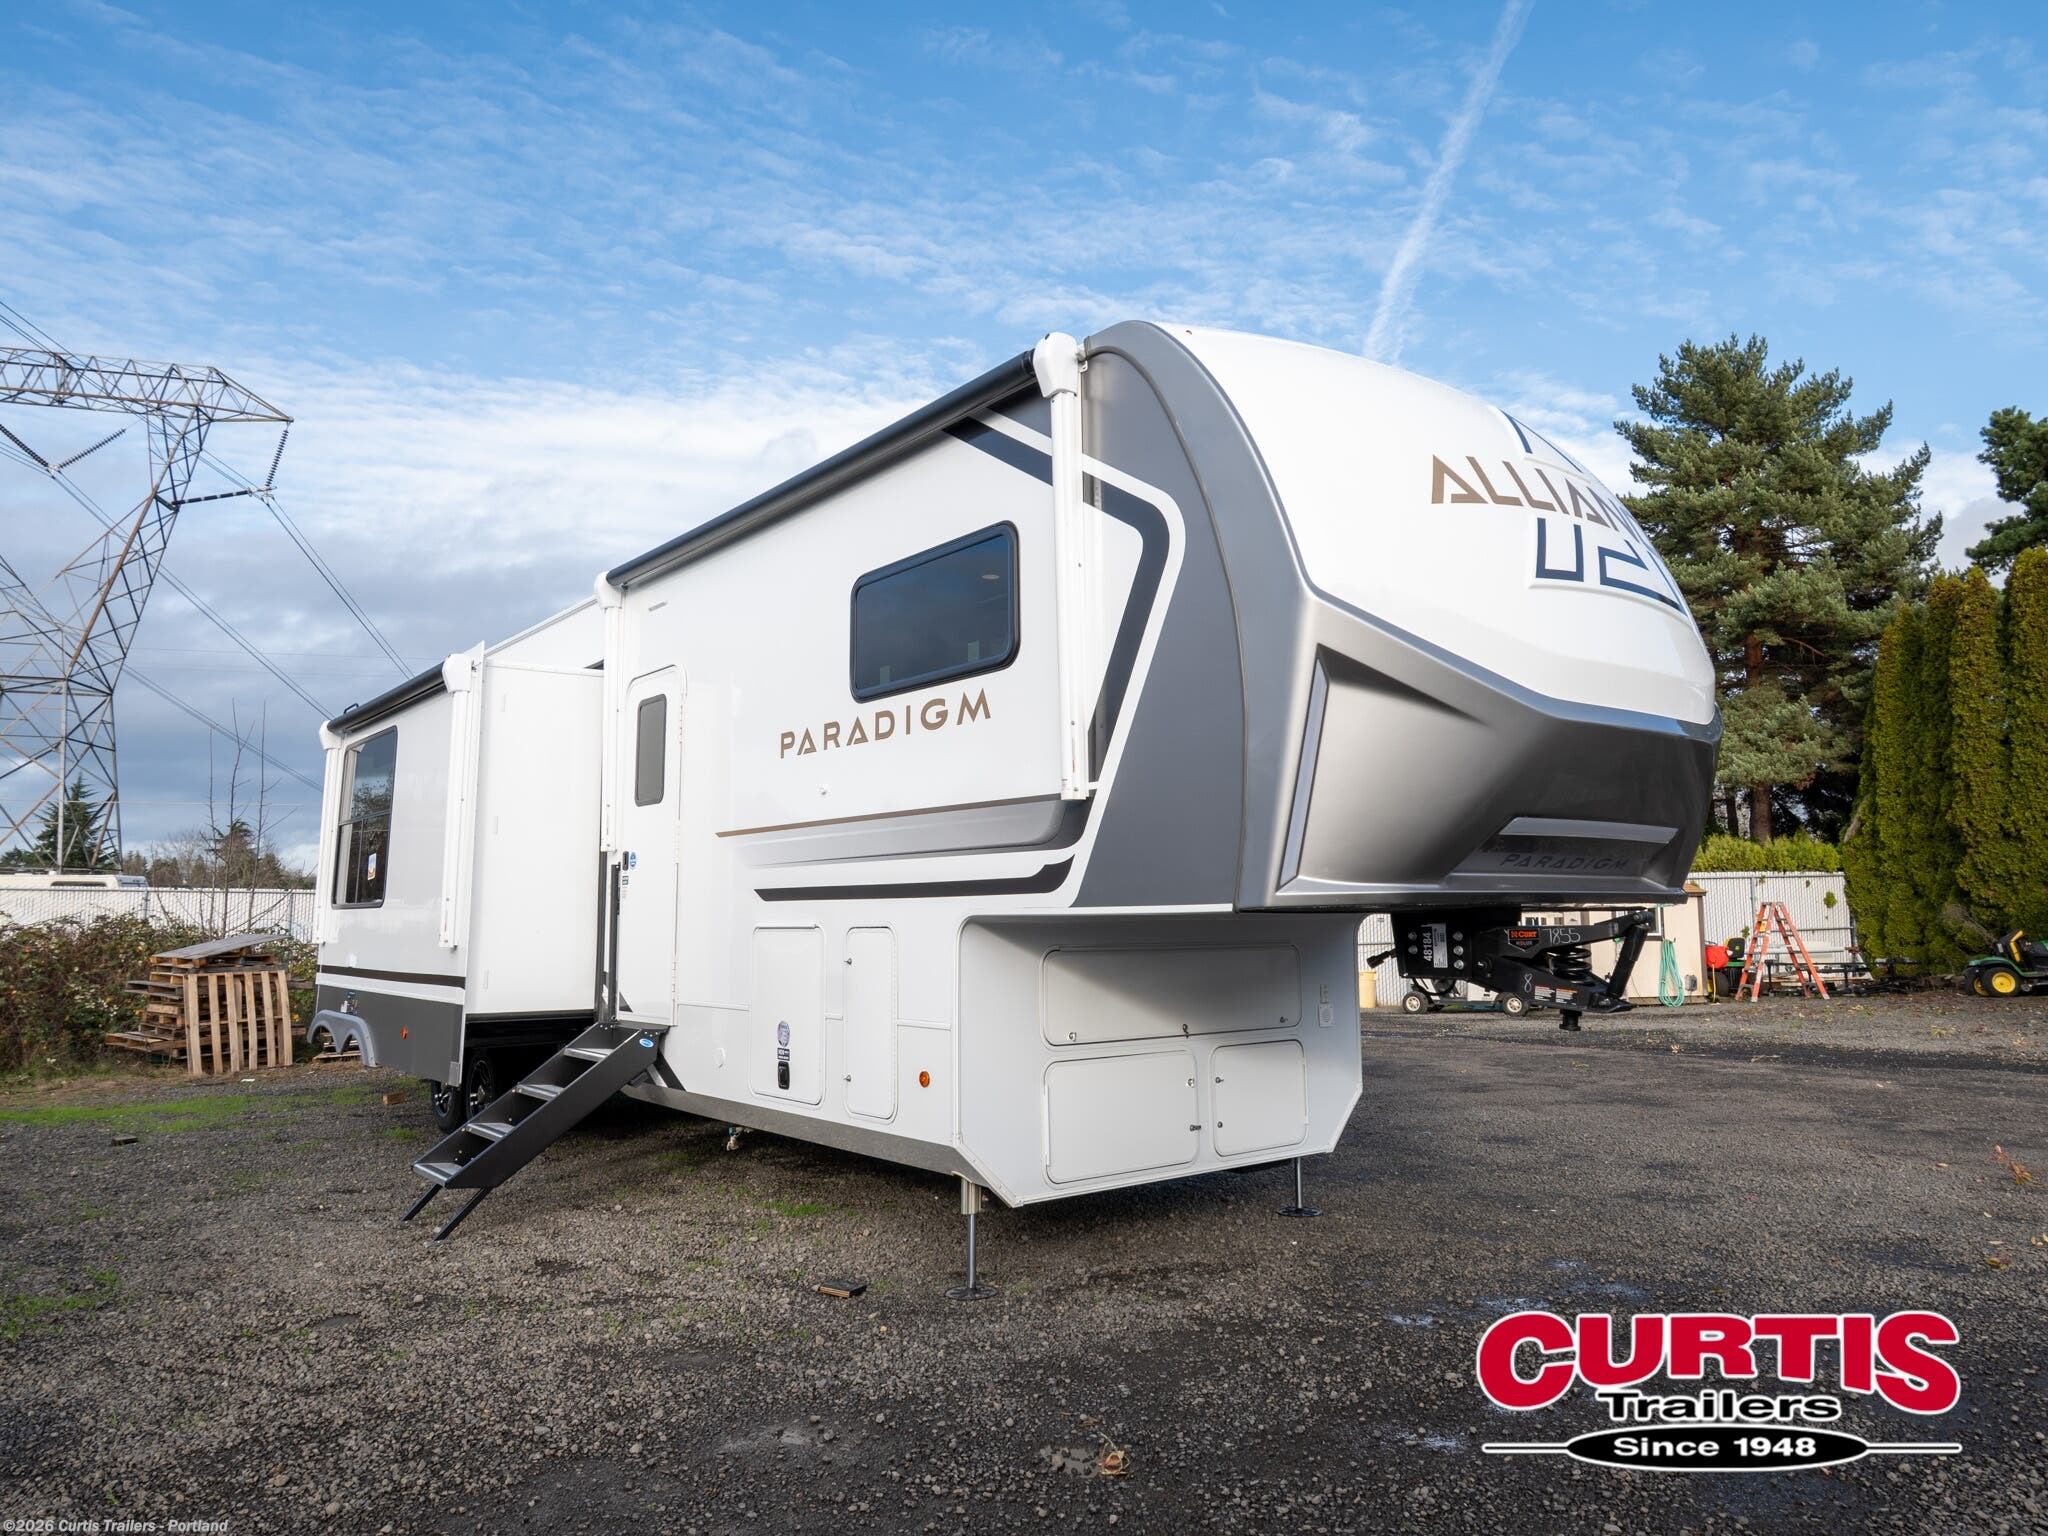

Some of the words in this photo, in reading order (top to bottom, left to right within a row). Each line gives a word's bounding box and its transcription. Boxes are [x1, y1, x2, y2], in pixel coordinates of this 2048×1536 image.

[1431, 454, 1644, 545] ALLIAN
[779, 687, 992, 760] PARADIGM
[1500, 853, 1631, 871] PARADIGM
[1422, 931, 1433, 962] 48184
[1542, 927, 1581, 946] 7855
